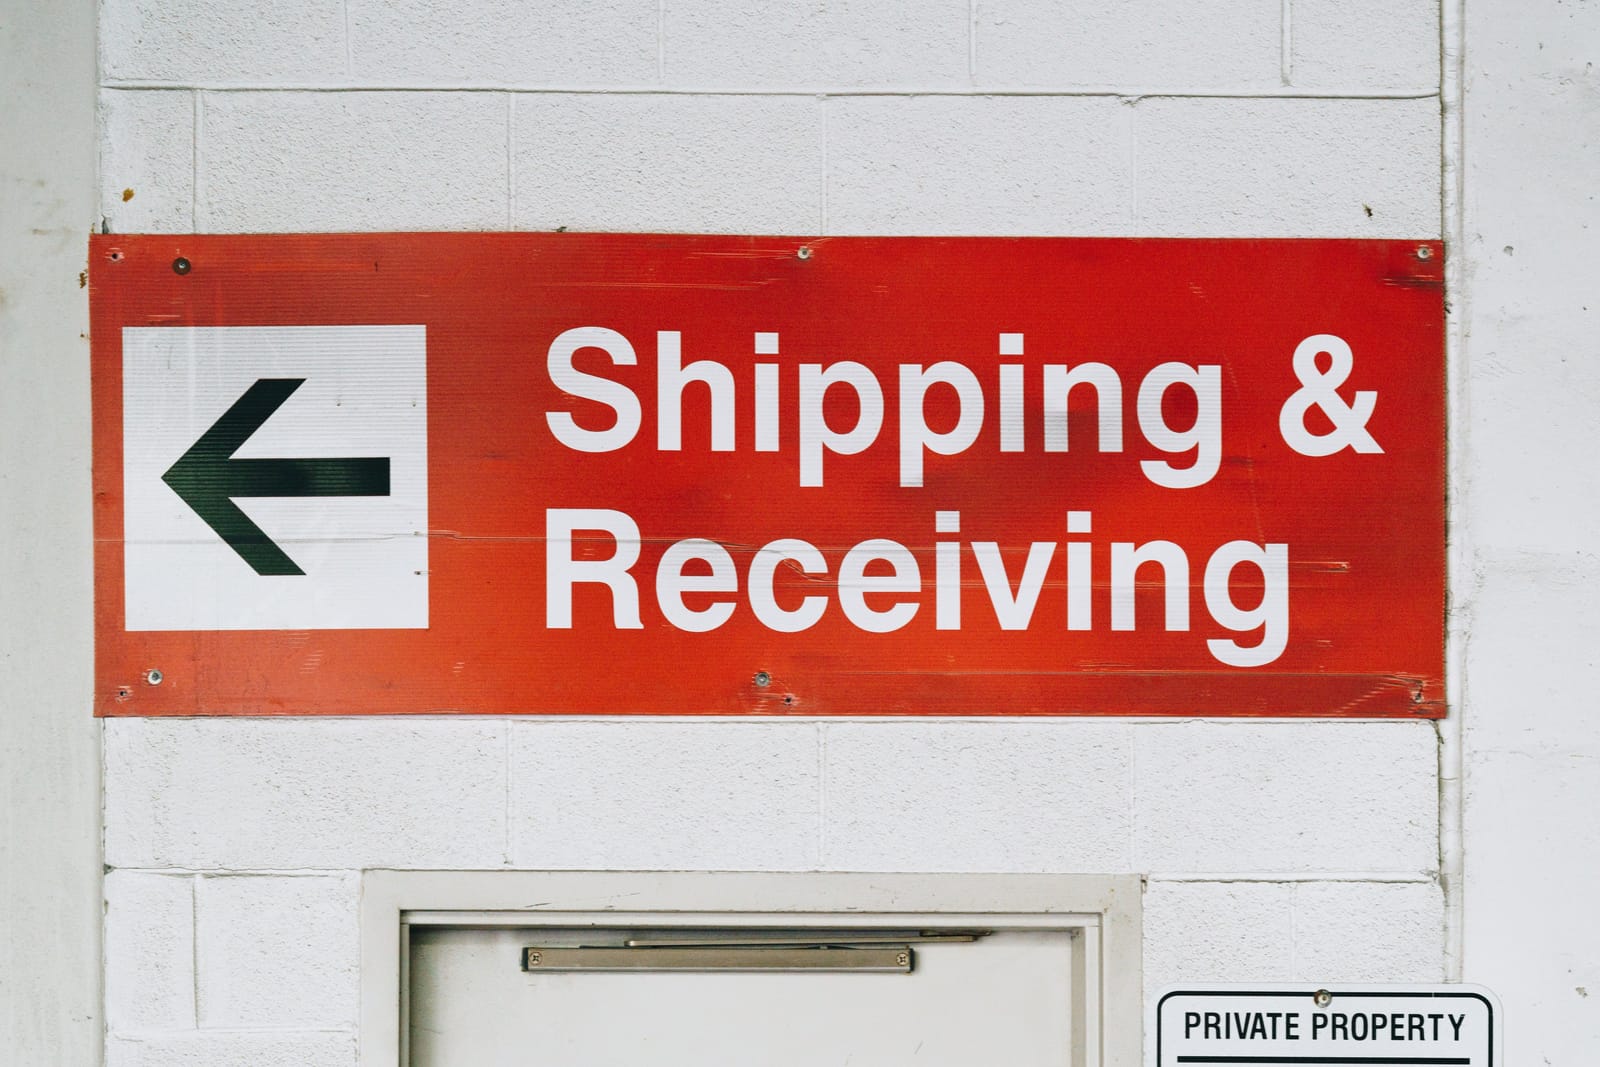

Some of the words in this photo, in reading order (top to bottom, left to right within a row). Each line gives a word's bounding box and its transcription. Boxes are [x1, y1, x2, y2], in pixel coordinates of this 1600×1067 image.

[545, 326, 1223, 489] Shipping
[1278, 333, 1385, 457] &
[545, 508, 1290, 668] Receiving
[1184, 1011, 1300, 1040] PRIVATE
[1312, 1012, 1466, 1042] PROPERTY
